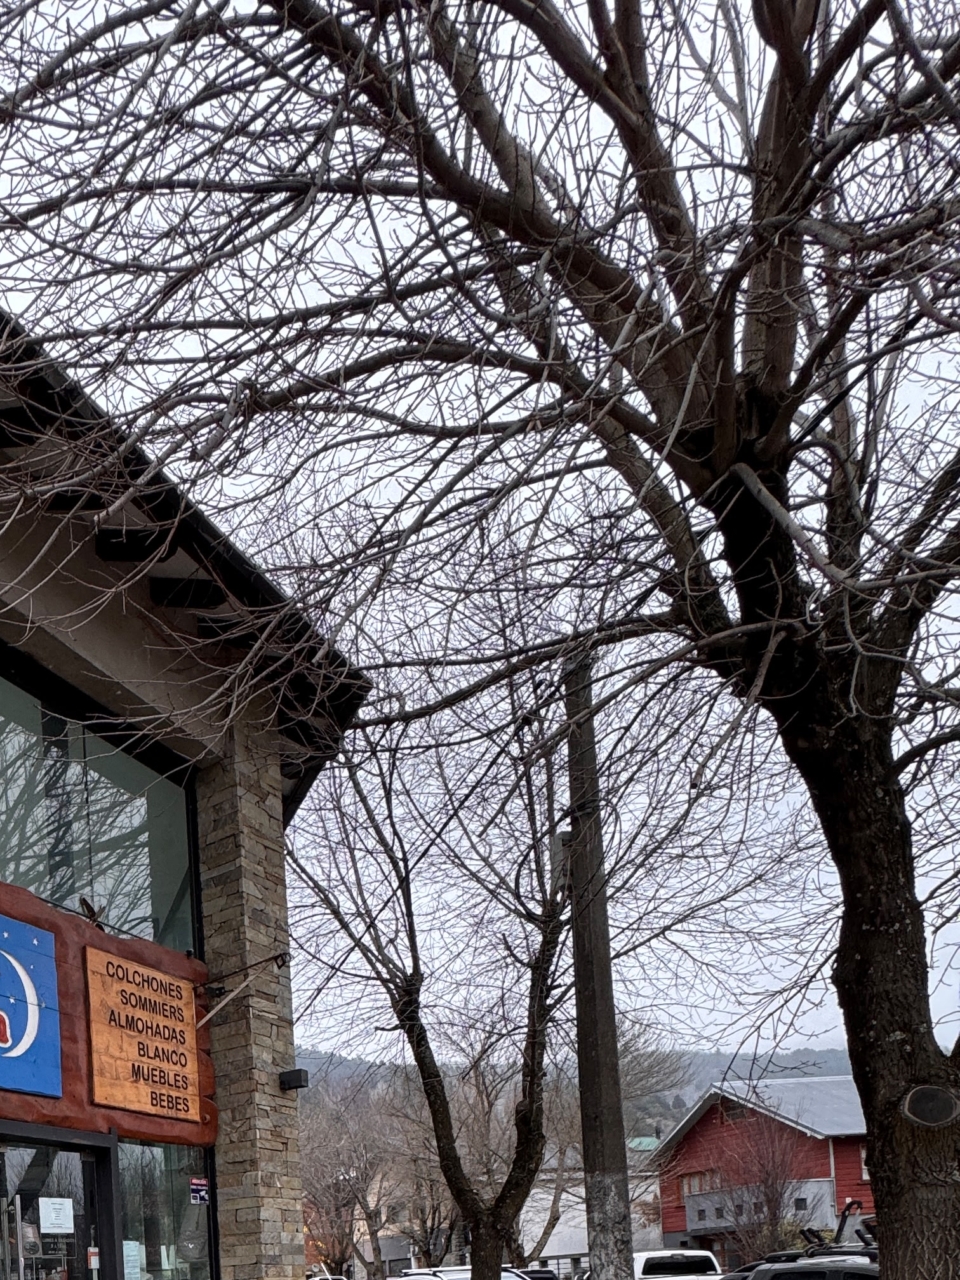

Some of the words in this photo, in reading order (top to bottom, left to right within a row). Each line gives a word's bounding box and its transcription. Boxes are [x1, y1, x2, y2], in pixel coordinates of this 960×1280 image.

[106, 961, 183, 1001] COLCHONES
[120, 989, 185, 1023] SOMMIERS
[108, 1009, 186, 1045] ALMOHADAS
[137, 1041, 188, 1068] BLANCO
[131, 1063, 189, 1091] MUEBLES
[150, 1091, 190, 1113] BEBES
